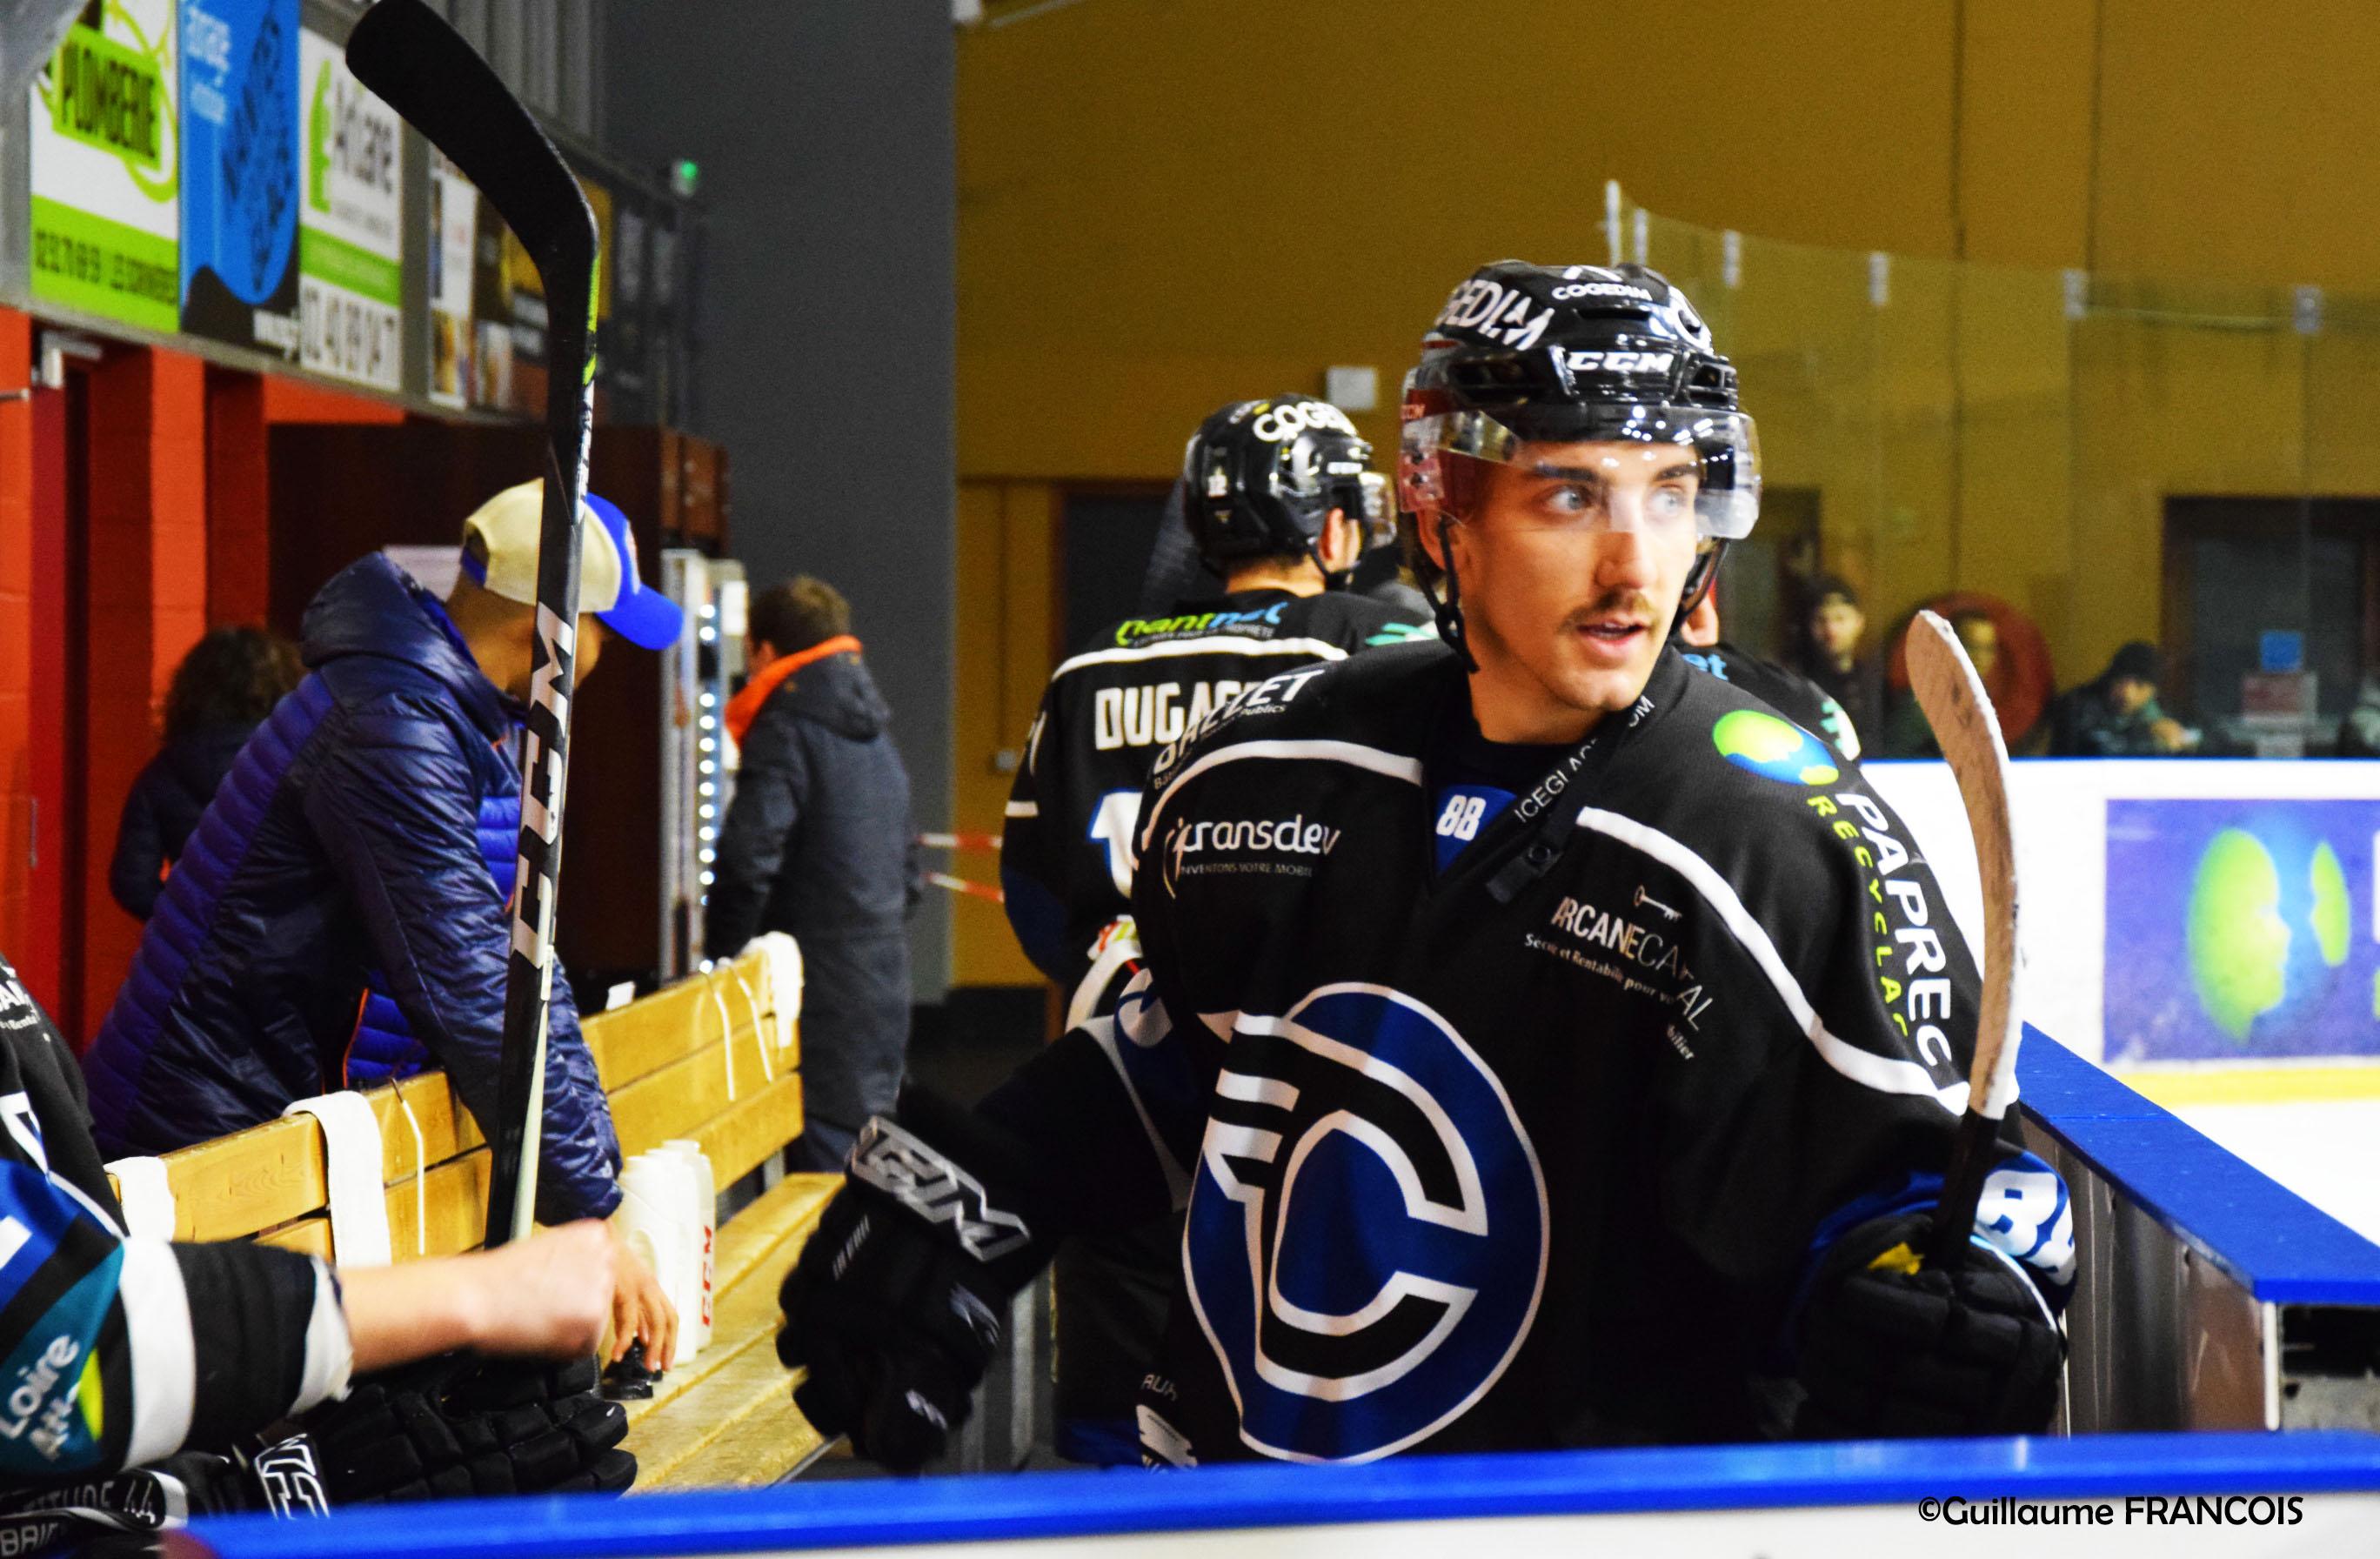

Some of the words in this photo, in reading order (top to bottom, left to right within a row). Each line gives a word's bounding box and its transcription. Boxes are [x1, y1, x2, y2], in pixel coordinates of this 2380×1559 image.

[1552, 283, 1653, 302] COGEDIM
[1567, 351, 1675, 372] CCM
[510, 601, 574, 970] CCM
[1436, 793, 1487, 841] 88
[1170, 813, 1341, 874] transdev
[1835, 793, 1952, 1067] PAPREC
[703, 1224, 713, 1328] CCM
[0, 1335, 80, 1440] Loire
